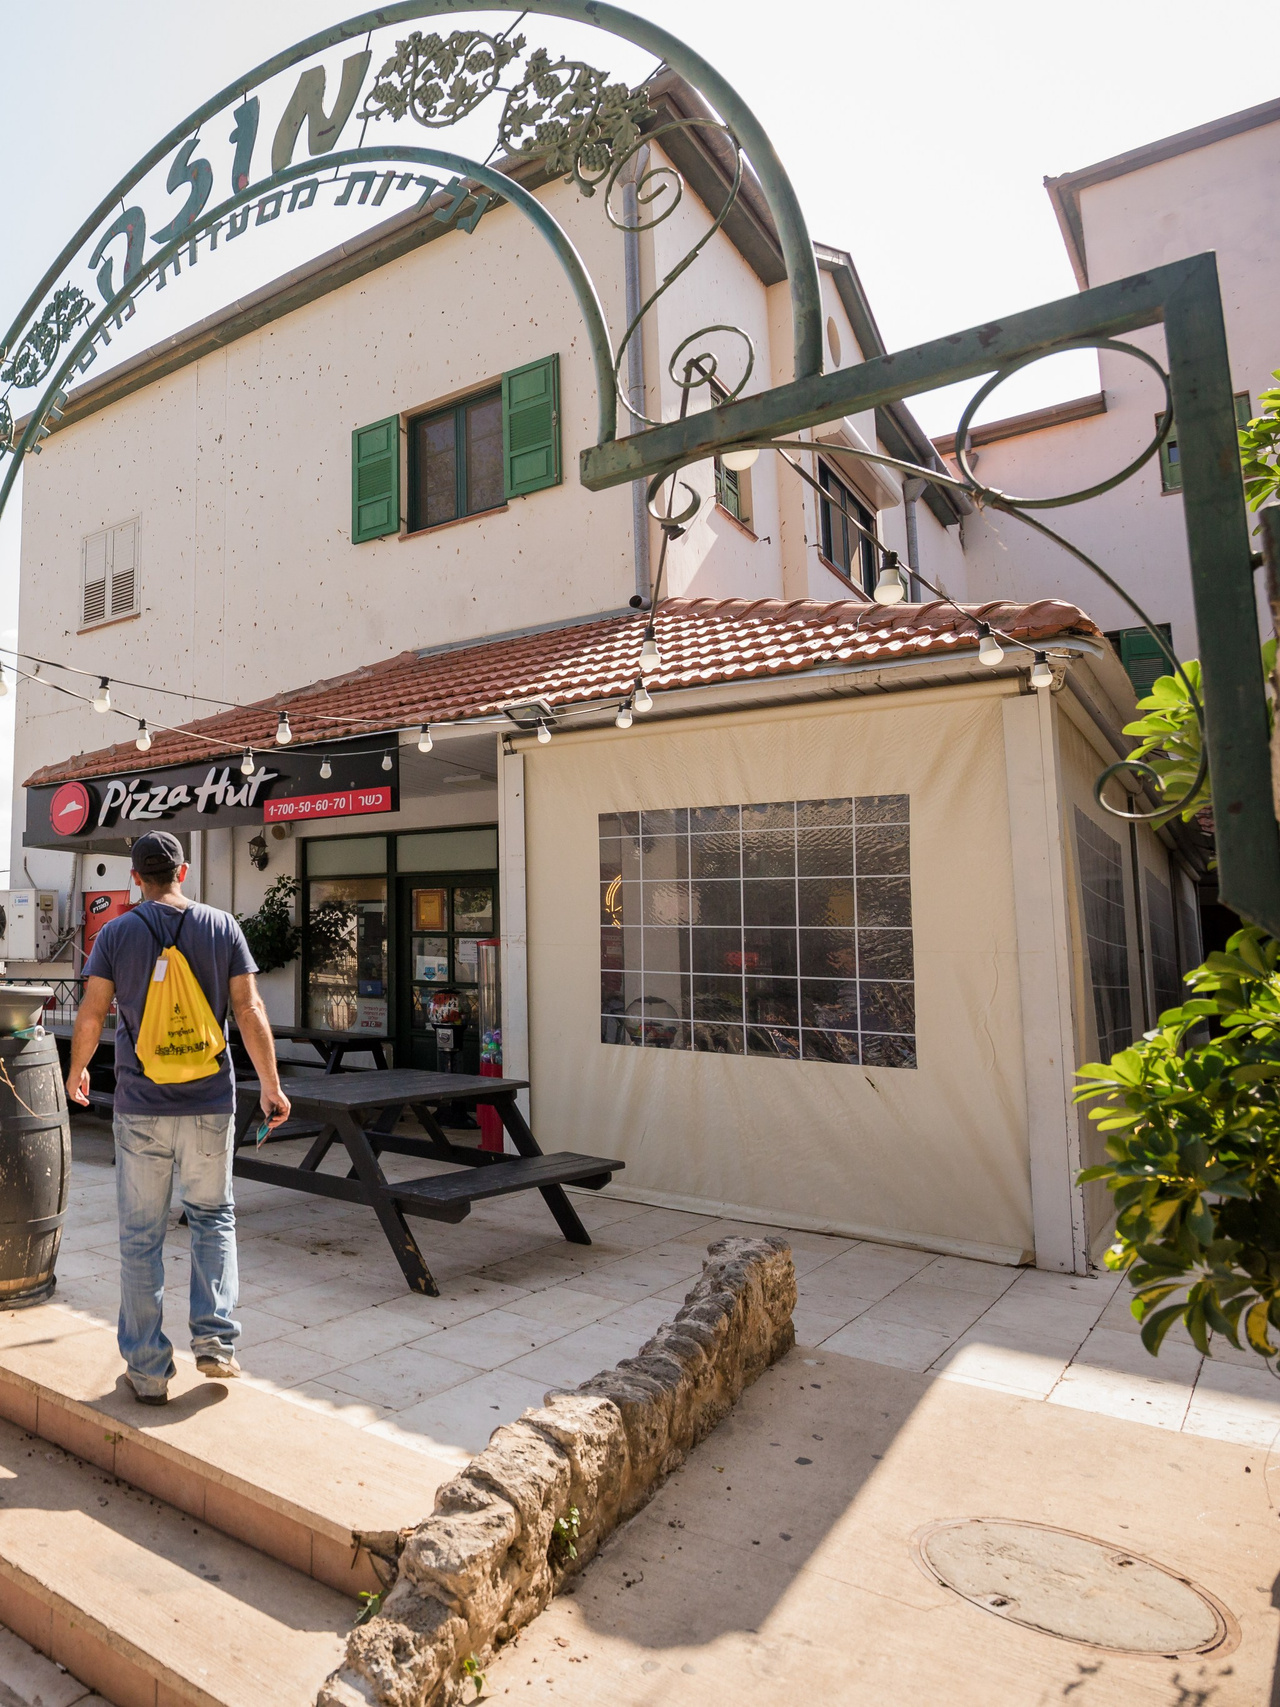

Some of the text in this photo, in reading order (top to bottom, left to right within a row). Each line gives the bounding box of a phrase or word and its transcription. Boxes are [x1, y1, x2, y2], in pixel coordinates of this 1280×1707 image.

[97, 765, 279, 828] Pizza Hut
[357, 794, 384, 808] כשר
[268, 797, 346, 817] 1-700-50-60-70
[94, 897, 106, 906] כשר
